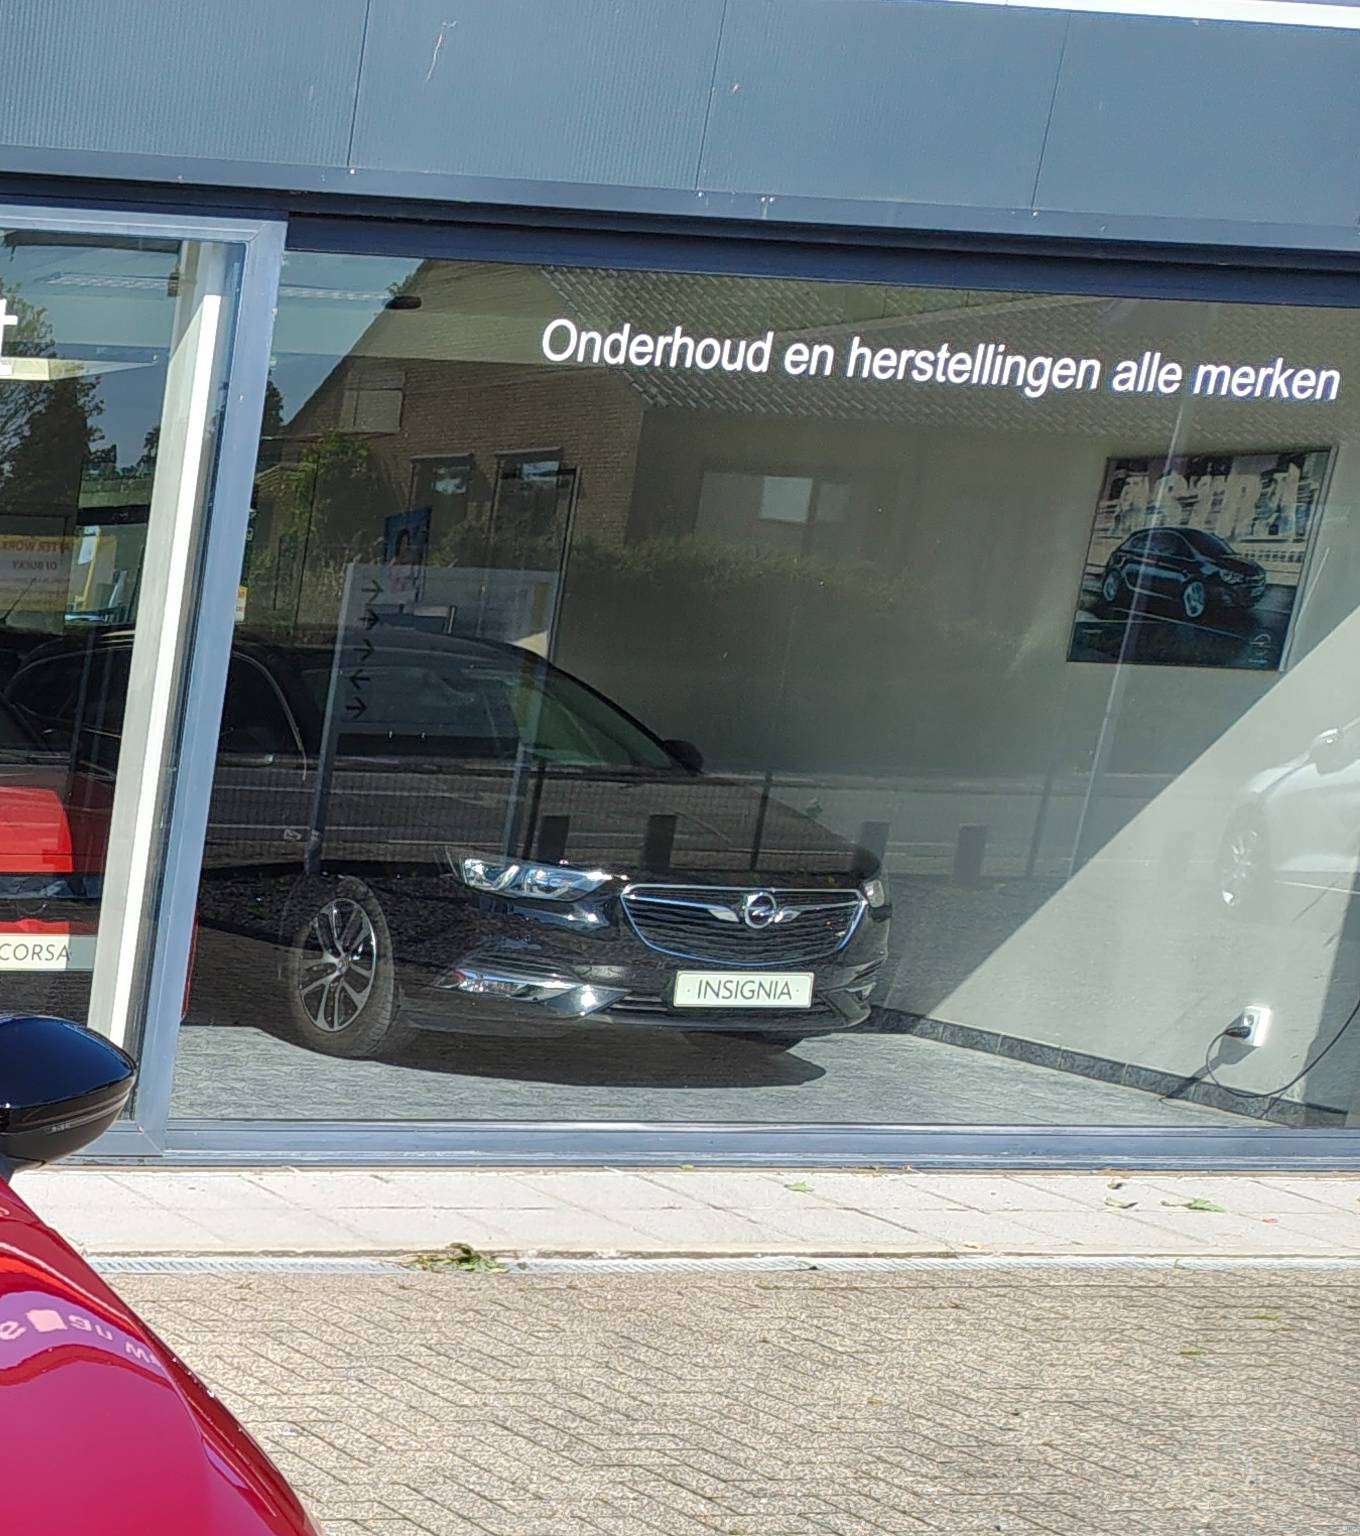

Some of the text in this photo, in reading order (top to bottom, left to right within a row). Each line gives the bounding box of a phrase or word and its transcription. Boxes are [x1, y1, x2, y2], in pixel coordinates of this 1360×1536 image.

[541, 318, 1341, 400] Onderhoud en herstellingen alle merken
[697, 979, 792, 1000] INSIGNIA
